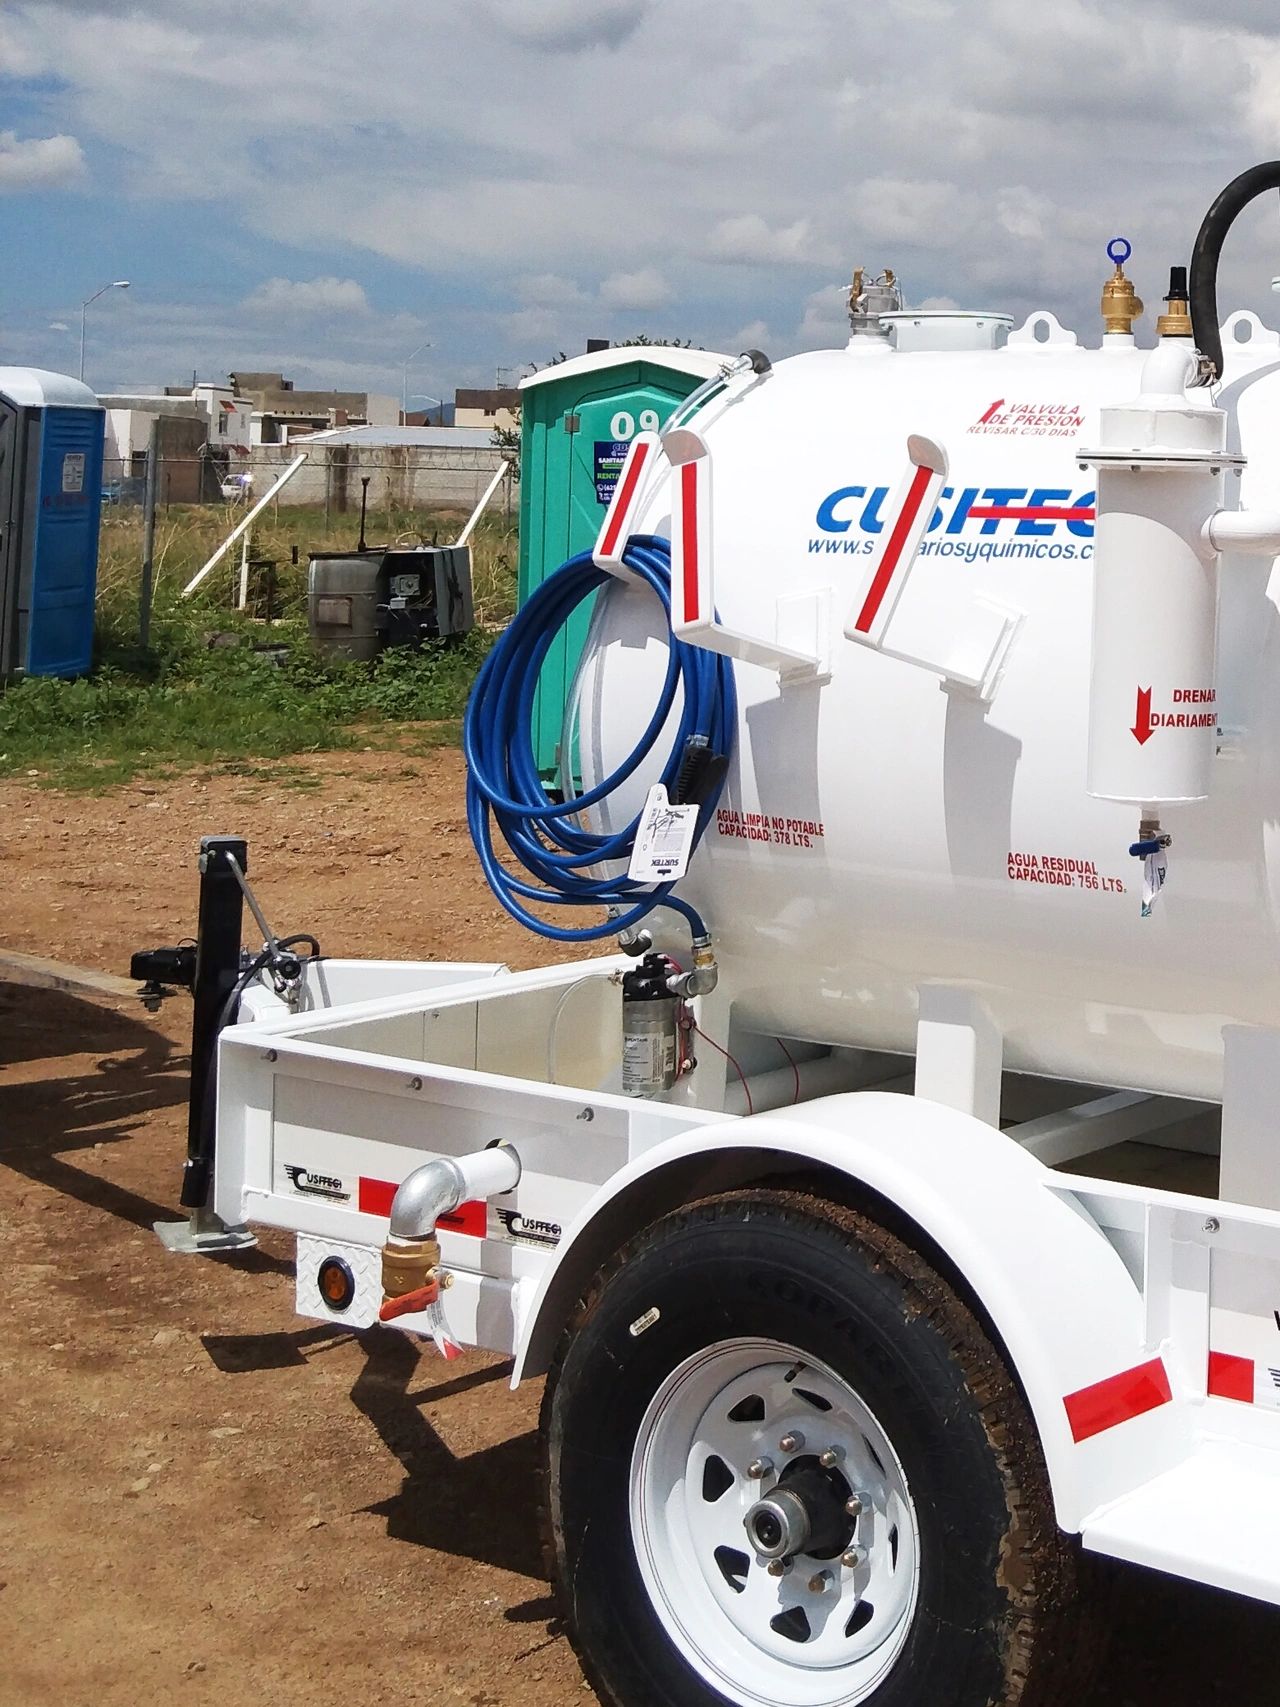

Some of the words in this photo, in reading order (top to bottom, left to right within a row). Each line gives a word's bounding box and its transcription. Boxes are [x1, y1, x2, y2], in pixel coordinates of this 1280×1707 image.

[988, 414, 1012, 425] DE
[1012, 415, 1085, 427] PRESION
[1010, 404, 1081, 415] VALVULA
[610, 409, 660, 441] 09
[966, 426, 1018, 435] REVISAR
[1048, 428, 1078, 437] DIAS
[808, 538, 1094, 563] www.sariosyquímicos.c
[717, 809, 740, 824] AGUA
[741, 812, 770, 829] LIMPIA
[772, 816, 785, 830] NO
[786, 819, 824, 836] POTABLE
[718, 823, 772, 842] CAPACIDAD:
[774, 831, 791, 845] 378
[792, 833, 813, 848] LTS.
[651, 859, 679, 867] SURTEK
[1007, 852, 1038, 868] AGUA
[1041, 856, 1098, 875] RESIDUAL
[1008, 866, 1075, 886] CAPACIDAD:
[1078, 875, 1099, 890] 756
[1102, 877, 1127, 893] LTS.
